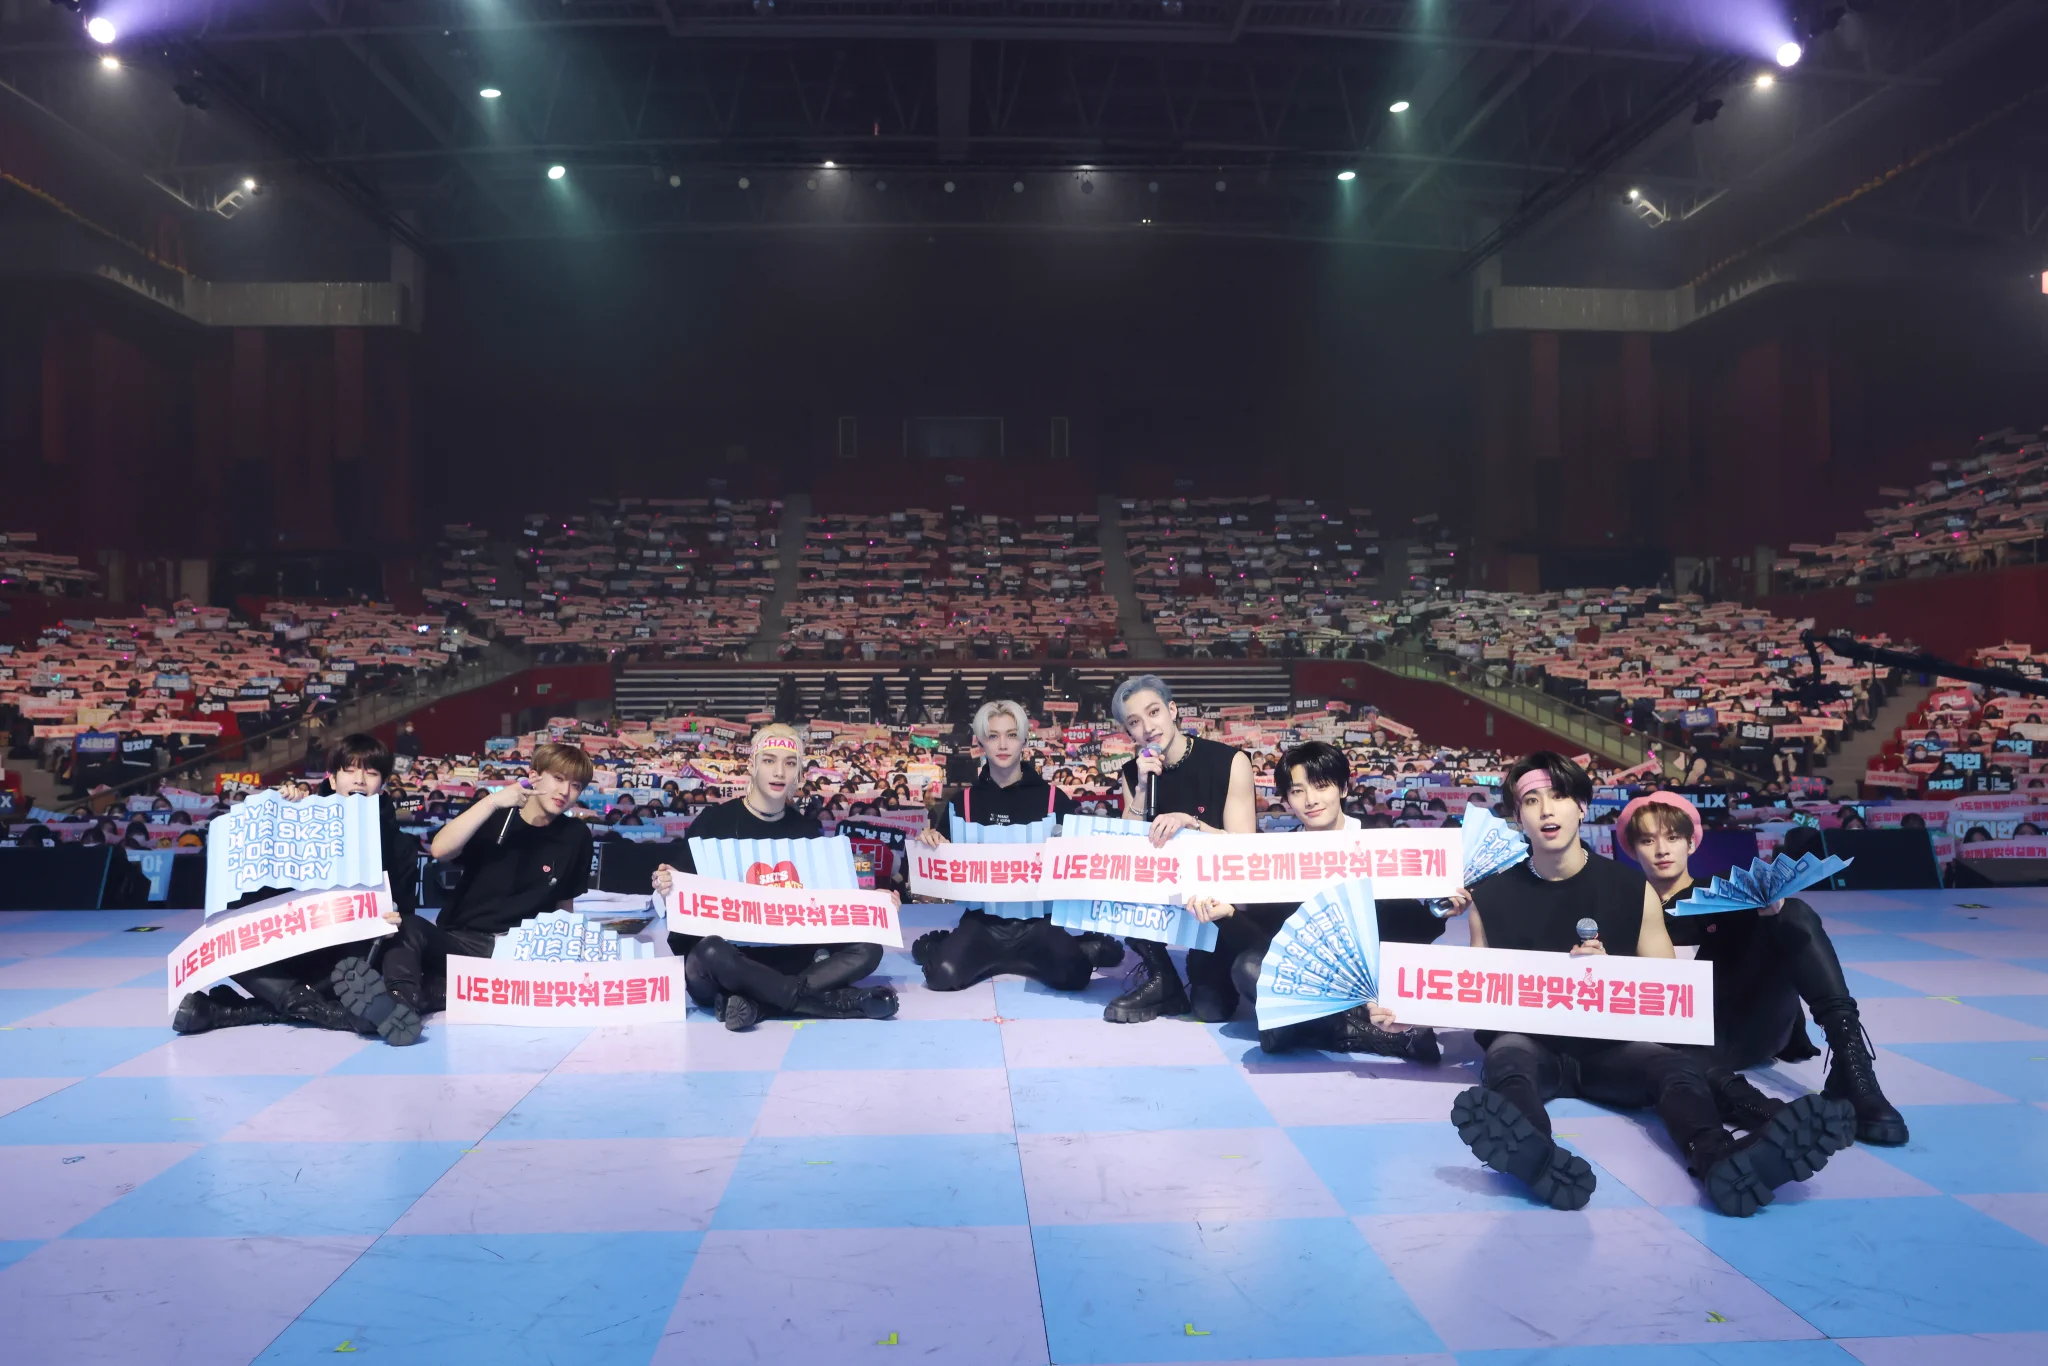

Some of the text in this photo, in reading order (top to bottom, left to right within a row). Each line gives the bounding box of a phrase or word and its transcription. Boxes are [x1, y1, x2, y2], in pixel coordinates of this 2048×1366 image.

[263, 799, 278, 818] 외
[281, 803, 344, 823] 출입금지
[278, 820, 344, 841] SKZ'S
[918, 856, 948, 881] 나도
[950, 858, 987, 884] 함께
[1052, 853, 1182, 885] 나도 함께 발맞
[1197, 853, 1245, 882] 나도
[1247, 852, 1295, 881] 함께
[1299, 846, 1374, 880] 발맞춰
[1376, 848, 1446, 877] 걸을게
[678, 890, 889, 930] 나도 함께 발맞춰 걸을게
[175, 891, 378, 989] 나도 함께 발맞춰 걸을게
[553, 919, 570, 938] 외
[457, 974, 670, 1008] 나도 함께 발맞춰 걸을게
[1397, 966, 1454, 1001] 나도
[1456, 971, 1513, 1006] 함께
[1517, 972, 1605, 1013] 발맞춰
[1608, 978, 1694, 1019] 걸을게
